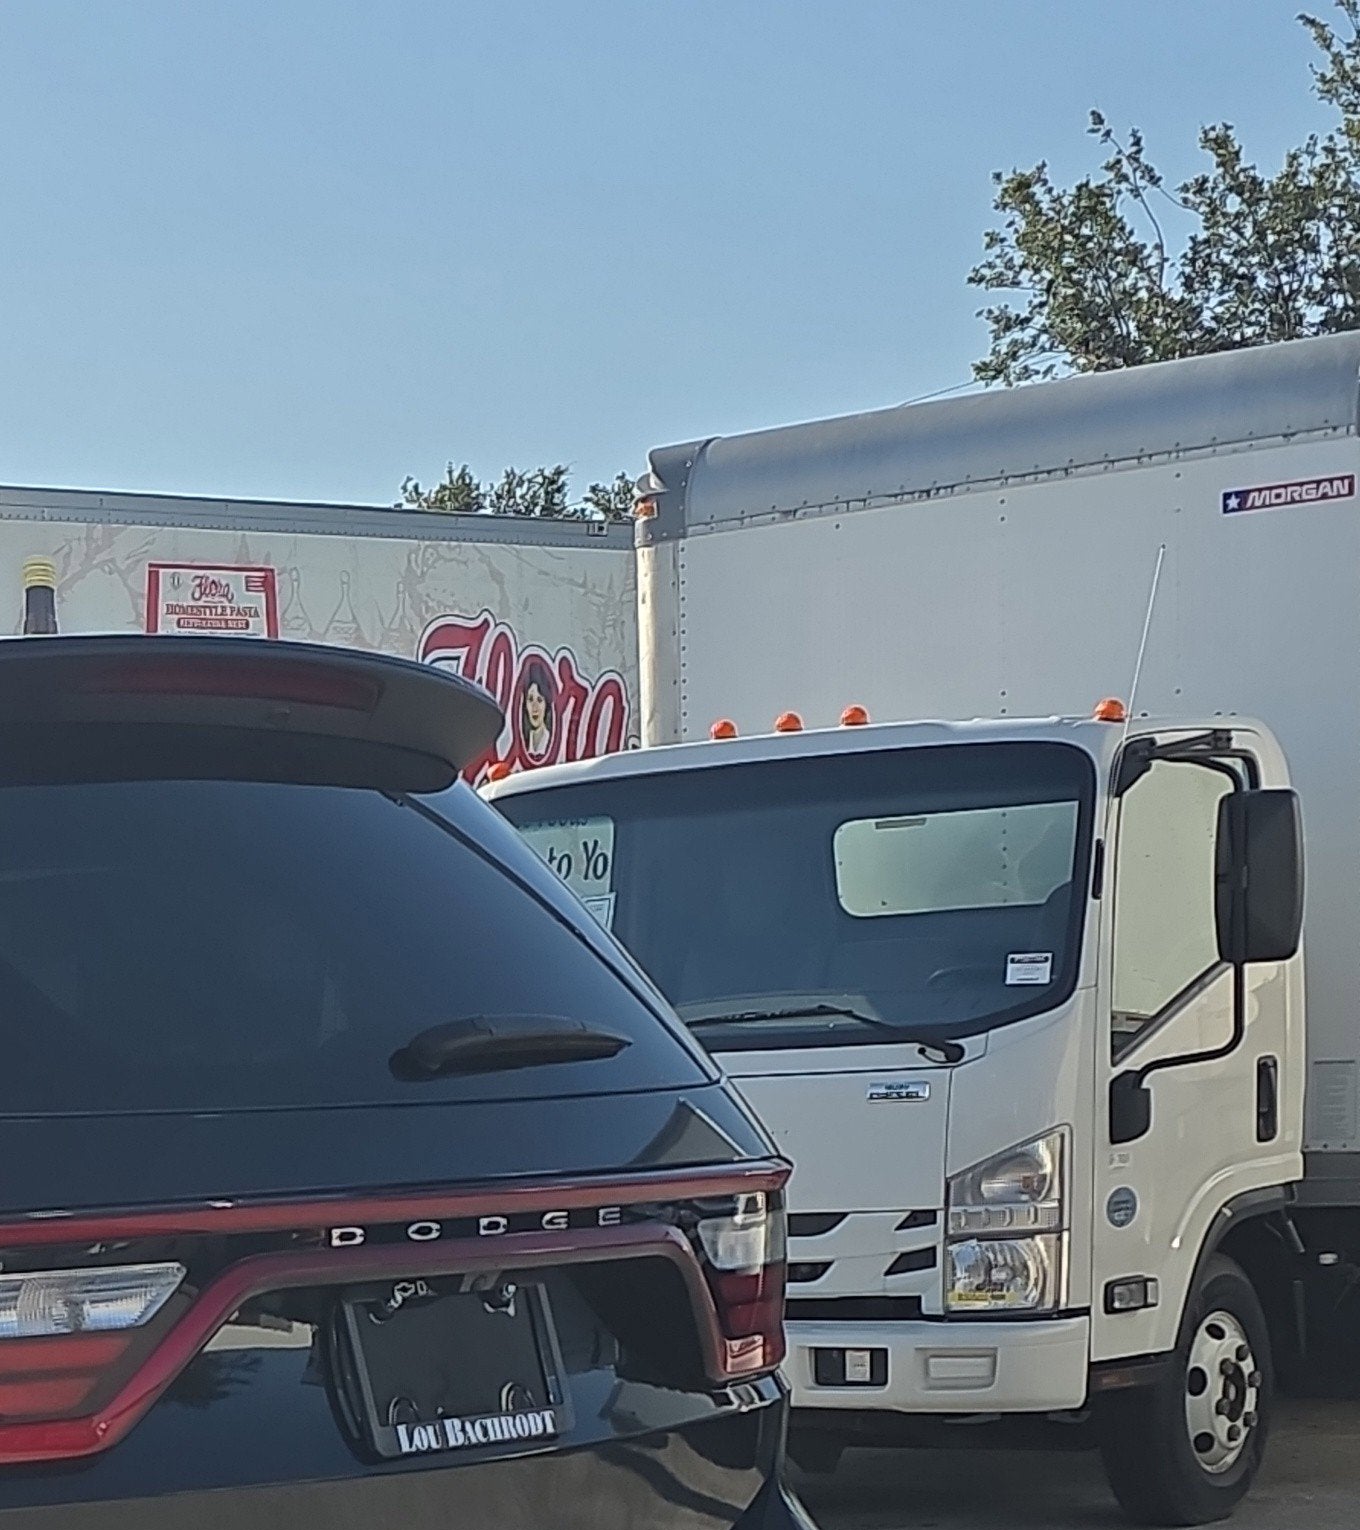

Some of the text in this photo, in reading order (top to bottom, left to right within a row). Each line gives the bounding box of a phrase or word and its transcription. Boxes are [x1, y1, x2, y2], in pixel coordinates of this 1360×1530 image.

[1245, 479, 1350, 508] MORGAN
[230, 604, 260, 618] PASTA
[330, 1205, 622, 1248] DODGE
[396, 1410, 555, 1453] LOU BACHRODT
